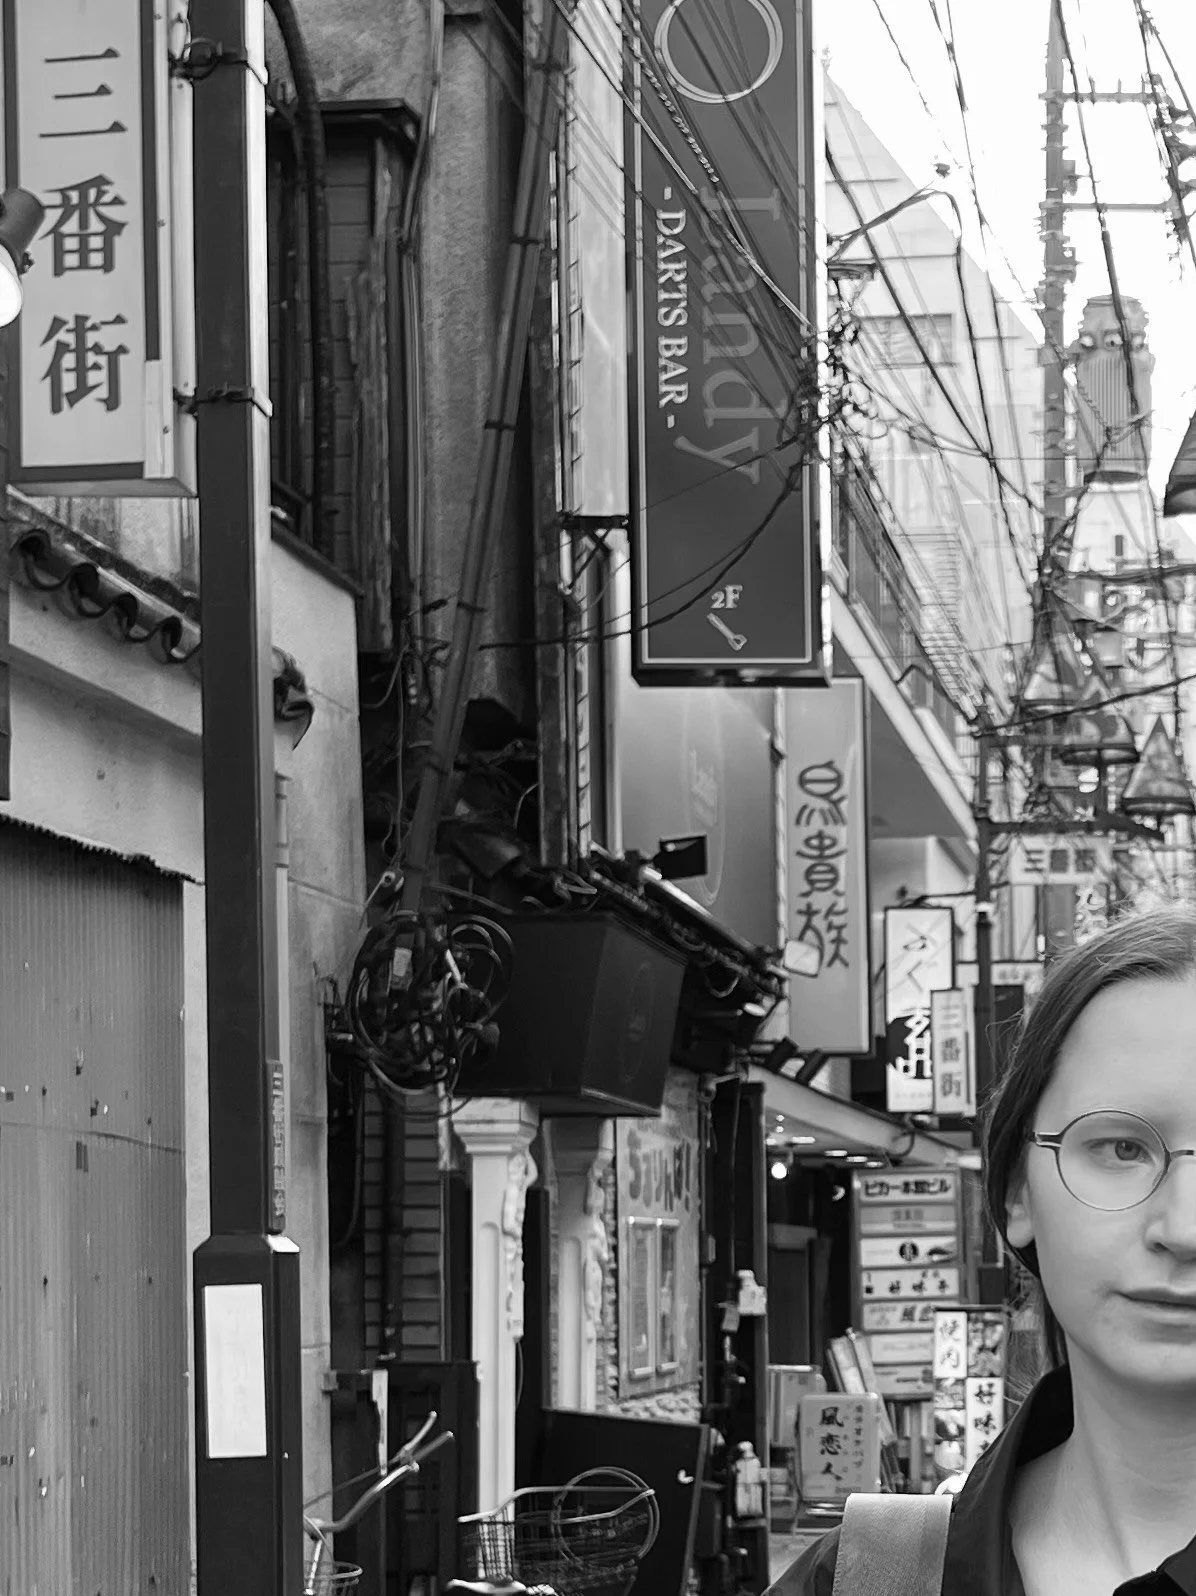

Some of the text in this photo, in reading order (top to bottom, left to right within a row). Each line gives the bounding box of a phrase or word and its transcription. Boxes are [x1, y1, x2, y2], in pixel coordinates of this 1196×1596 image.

[40, 47, 129, 415] 三番街
[656, 208, 688, 407] DARTS BAR
[711, 584, 744, 611] 2F
[794, 760, 850, 969] 鳥貴族
